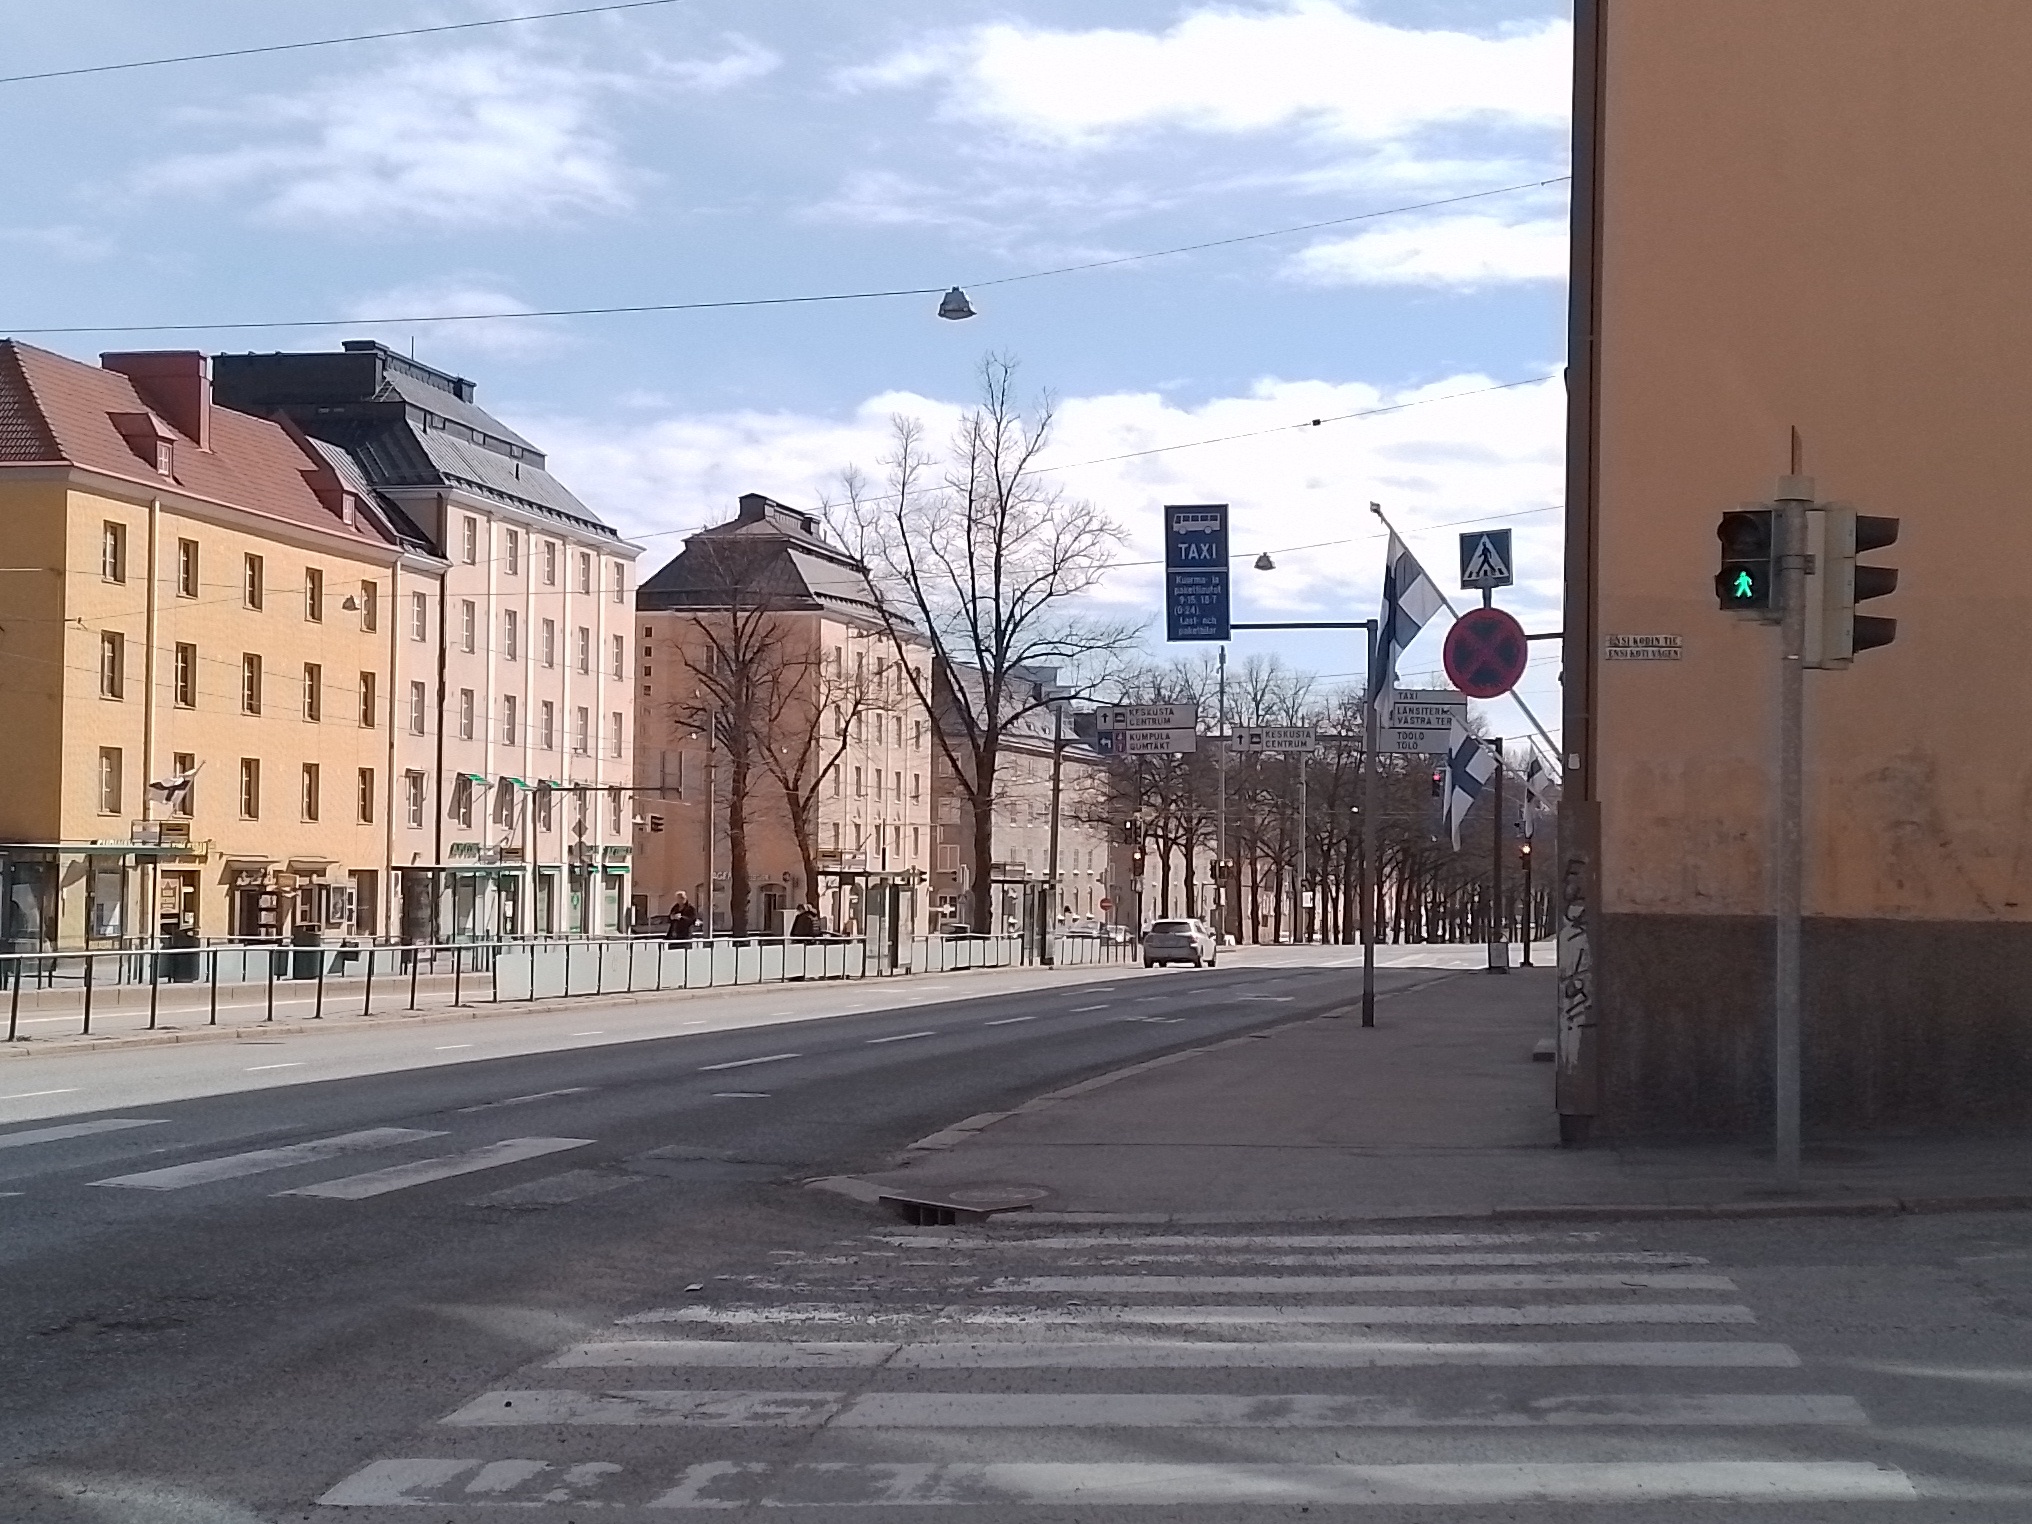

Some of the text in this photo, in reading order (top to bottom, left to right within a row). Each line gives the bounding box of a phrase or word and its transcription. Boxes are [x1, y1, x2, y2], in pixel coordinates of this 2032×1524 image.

[1178, 543, 1217, 560] TAXI
[1212, 575, 1220, 586] ja
[1202, 616, 1217, 625] och
[1663, 636, 1679, 646] TIE
[1398, 691, 1418, 700] TAXI
[1128, 707, 1175, 717] KESKUSTA
[1129, 717, 1171, 727] CENTRUM
[1129, 731, 1171, 742] KUMPULA
[1264, 730, 1312, 739] KESKUSTA
[1264, 739, 1308, 748] CENTRUM
